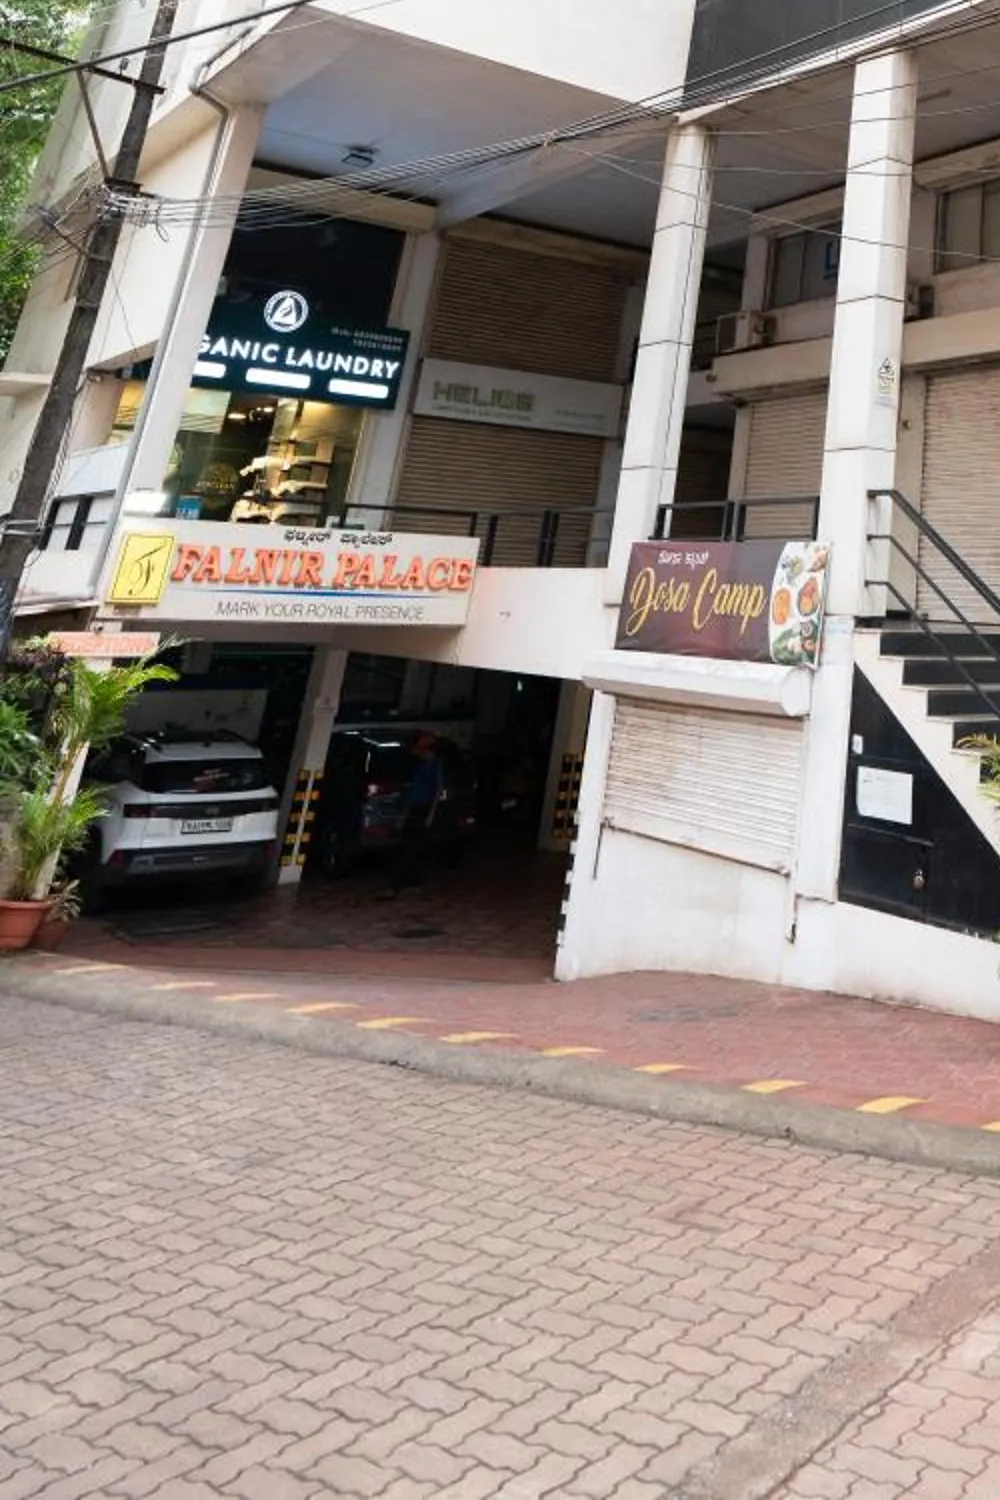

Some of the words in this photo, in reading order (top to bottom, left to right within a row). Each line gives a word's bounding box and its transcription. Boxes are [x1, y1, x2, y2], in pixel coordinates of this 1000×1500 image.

[285, 347, 400, 380] LAUNDRY
[171, 544, 323, 587] FALNIR
[332, 553, 472, 592] PALACE
[216, 601, 257, 615] MARK
[264, 602, 303, 617] YOUR
[306, 604, 350, 619] ROYAL
[355, 605, 425, 621] PRESENCE
[625, 567, 690, 636] Dosa
[693, 567, 768, 635] Camp
